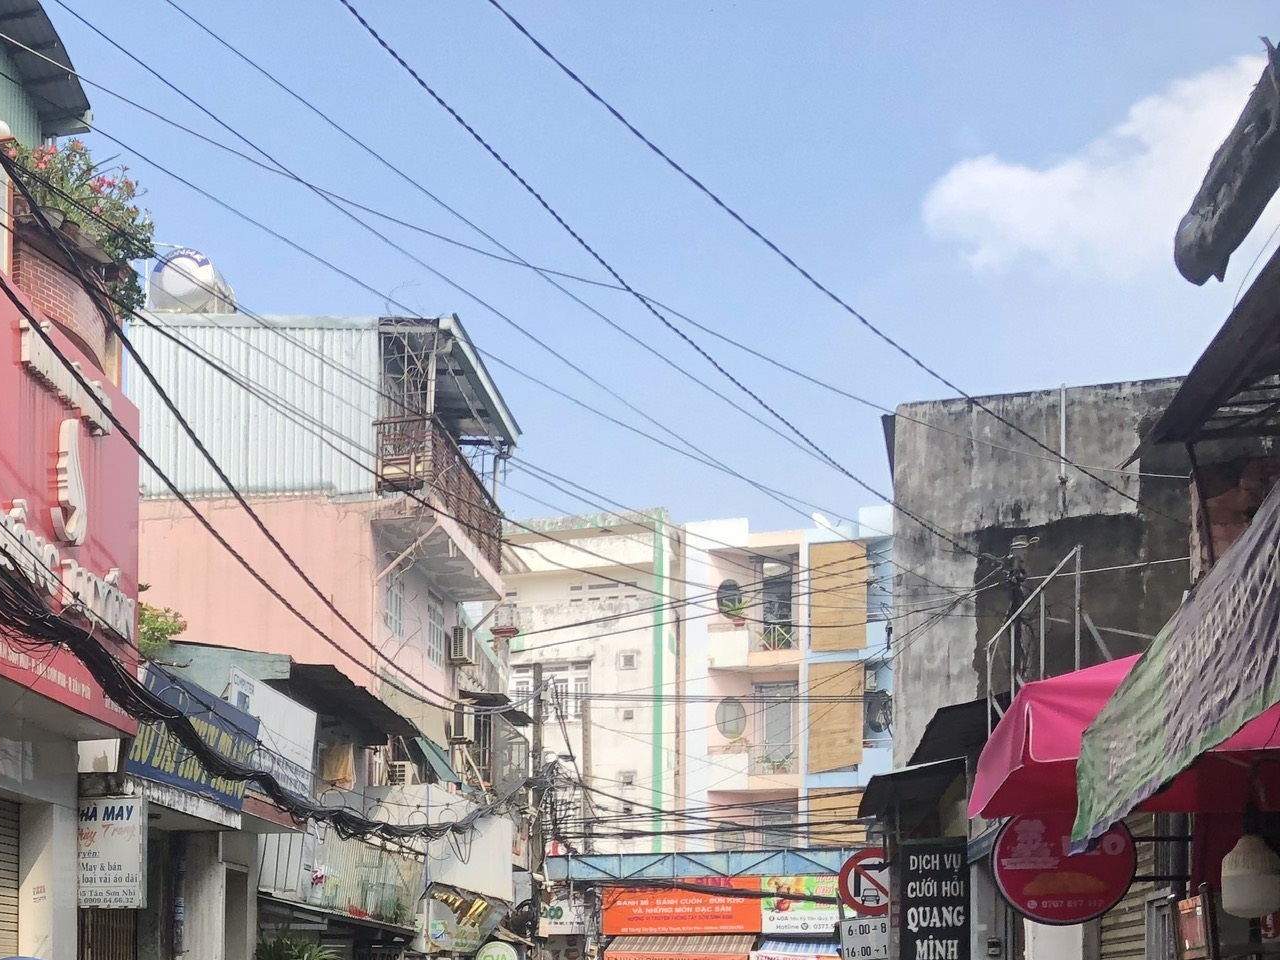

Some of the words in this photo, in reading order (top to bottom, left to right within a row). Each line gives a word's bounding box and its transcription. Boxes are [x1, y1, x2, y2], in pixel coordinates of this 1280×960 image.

[79, 803, 98, 821] HÀ
[102, 805, 134, 821] MAY
[78, 827, 97, 847] hùy
[81, 862, 97, 874] May
[107, 861, 122, 872] bán
[909, 853, 940, 874] DỊCH
[944, 853, 962, 872] VỤ
[907, 877, 937, 898] CƯỚI
[942, 876, 964, 897] HỎI
[632, 906, 643, 914] VÀ
[675, 905, 693, 913] MÓN
[907, 906, 965, 933] QUANG
[847, 924, 870, 936] 6:00
[846, 946, 872, 958] 16:00
